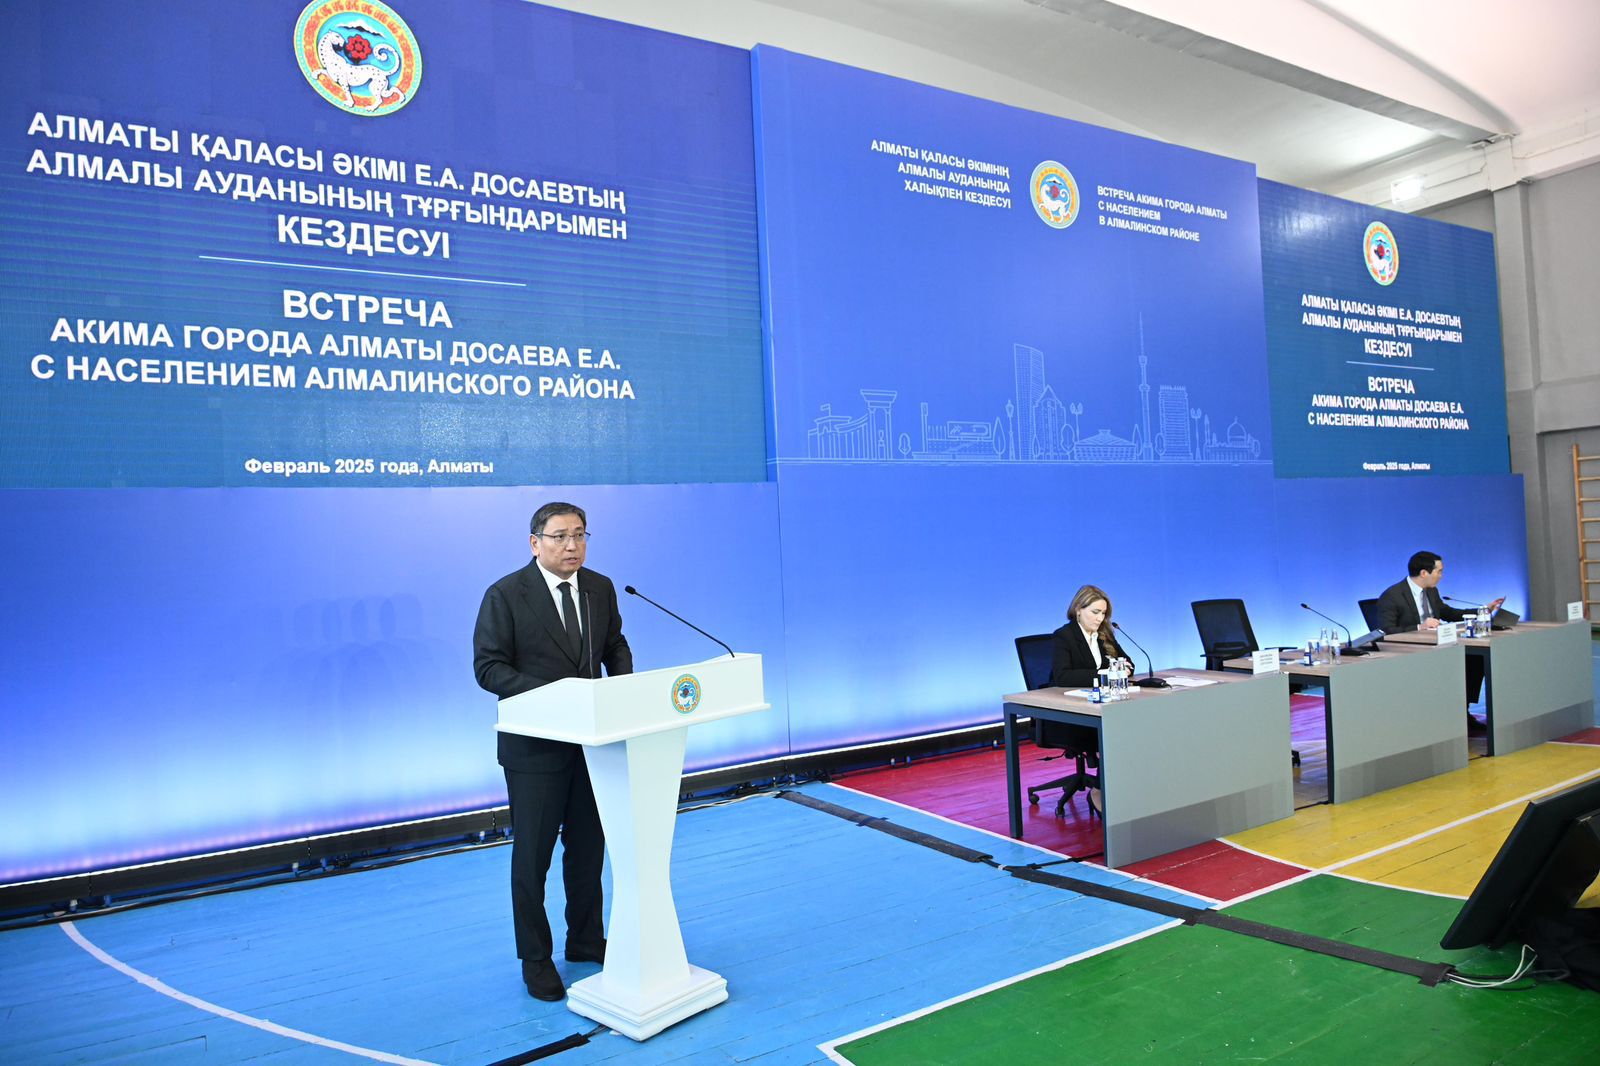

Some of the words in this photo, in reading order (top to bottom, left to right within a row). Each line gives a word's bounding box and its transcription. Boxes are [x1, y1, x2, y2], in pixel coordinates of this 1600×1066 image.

[28, 112, 178, 153] АЛМАТЫ
[192, 133, 322, 172] ҚАЛАСЫ
[333, 153, 406, 182] ӘКІМІ
[416, 164, 464, 190] Е.А.
[472, 172, 626, 214] ДОСАЕВТЫҢ
[871, 140, 918, 158] АЛМАТЫ
[922, 150, 965, 168] ҚАЛАСЫ
[968, 160, 1010, 178] ӘКІМІНІҢ
[898, 162, 945, 180] АЛМАЛЫ
[948, 172, 1010, 193] АУДАНЫНДА
[27, 150, 182, 188] АЛМАЛЫ
[194, 170, 393, 217] АУДАНЫНЫҢ
[401, 194, 626, 239] ТҰРҒЫНДАРЫМЕН
[905, 180, 962, 200] ХАЛЫҚПЕН
[965, 191, 1010, 208] КЕЗДЕСУІ
[1098, 186, 1135, 201] ВСТРЕЧА
[1136, 194, 1163, 207] АКИМА
[1165, 199, 1195, 214] ГОРОДА
[1196, 206, 1227, 219] АЛМАТЫ
[1098, 200, 1104, 210] С
[1106, 202, 1160, 220] НАСЕЛЕНИЕМ
[278, 214, 449, 258] КЕЗДЕСУІ
[1100, 216, 1105, 225] В
[1107, 217, 1168, 236] АЛМАЛИНСКОМ
[1170, 228, 1200, 241] РАЙОНЕ
[284, 290, 453, 328] ВСТРЕЧА
[1302, 294, 1339, 310] АЛМАТЫ
[1341, 300, 1376, 316] ҚАЛАСЫ
[1415, 311, 1461, 328] ДОСАЕВТЫҢ
[1302, 312, 1341, 328] АЛМАЛЫ
[50, 318, 174, 347] АКИМА
[184, 326, 312, 357] ГОРОДА
[320, 334, 442, 360] АЛМАТЫ
[450, 342, 572, 367] ДОСАЕВА
[578, 349, 620, 370] Е.А.
[1365, 339, 1412, 358] КЕЗДЕСУІ
[32, 354, 54, 378] С
[68, 356, 295, 388] НАСЕЛЕНИЕМ
[305, 367, 531, 396] АЛМАЛИНСКОГО
[539, 373, 635, 399] РАЙОНА
[1368, 376, 1415, 394] ВСТРЕЧА
[1312, 394, 1342, 408] АКИМА
[1344, 396, 1378, 411] ГОРОДА
[1379, 398, 1413, 411] АЛМАТЫ
[1414, 400, 1449, 413] ДОСАЕВА
[1308, 412, 1314, 424] С
[1316, 413, 1375, 426] НАСЕЛЕНИЕМ
[1376, 416, 1438, 428] АЛМАЛИНСКОГО
[1440, 416, 1469, 430] РАЙОНА
[245, 459, 330, 477] Февраль
[335, 459, 374, 473] 2025
[381, 462, 423, 475] года,
[428, 459, 493, 472] Алматы
